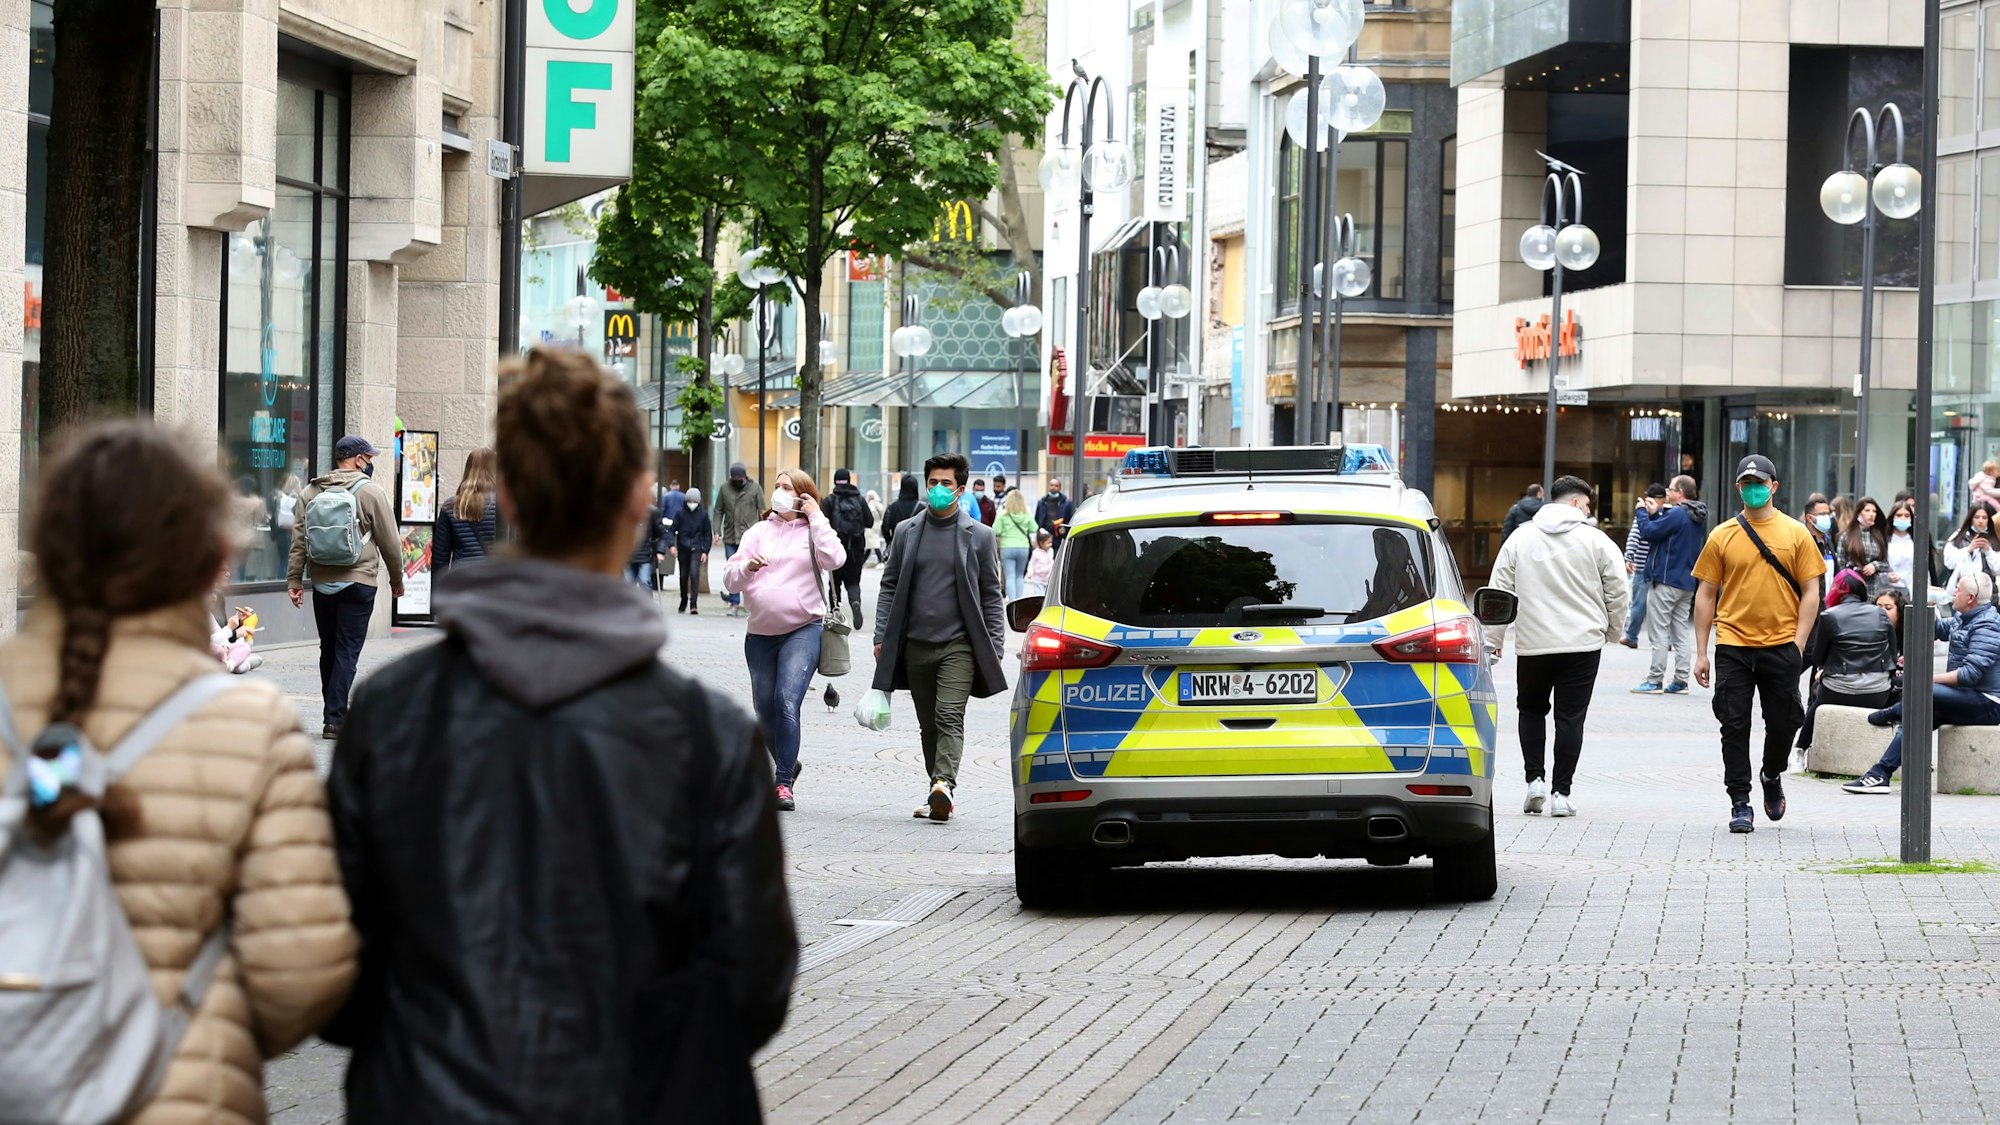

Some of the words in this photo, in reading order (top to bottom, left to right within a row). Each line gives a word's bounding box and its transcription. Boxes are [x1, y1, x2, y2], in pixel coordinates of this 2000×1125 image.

[1066, 683, 1146, 704] POLIZEI
[1192, 674, 1230, 697] NRW
[1243, 673, 1315, 695] 4-6202
